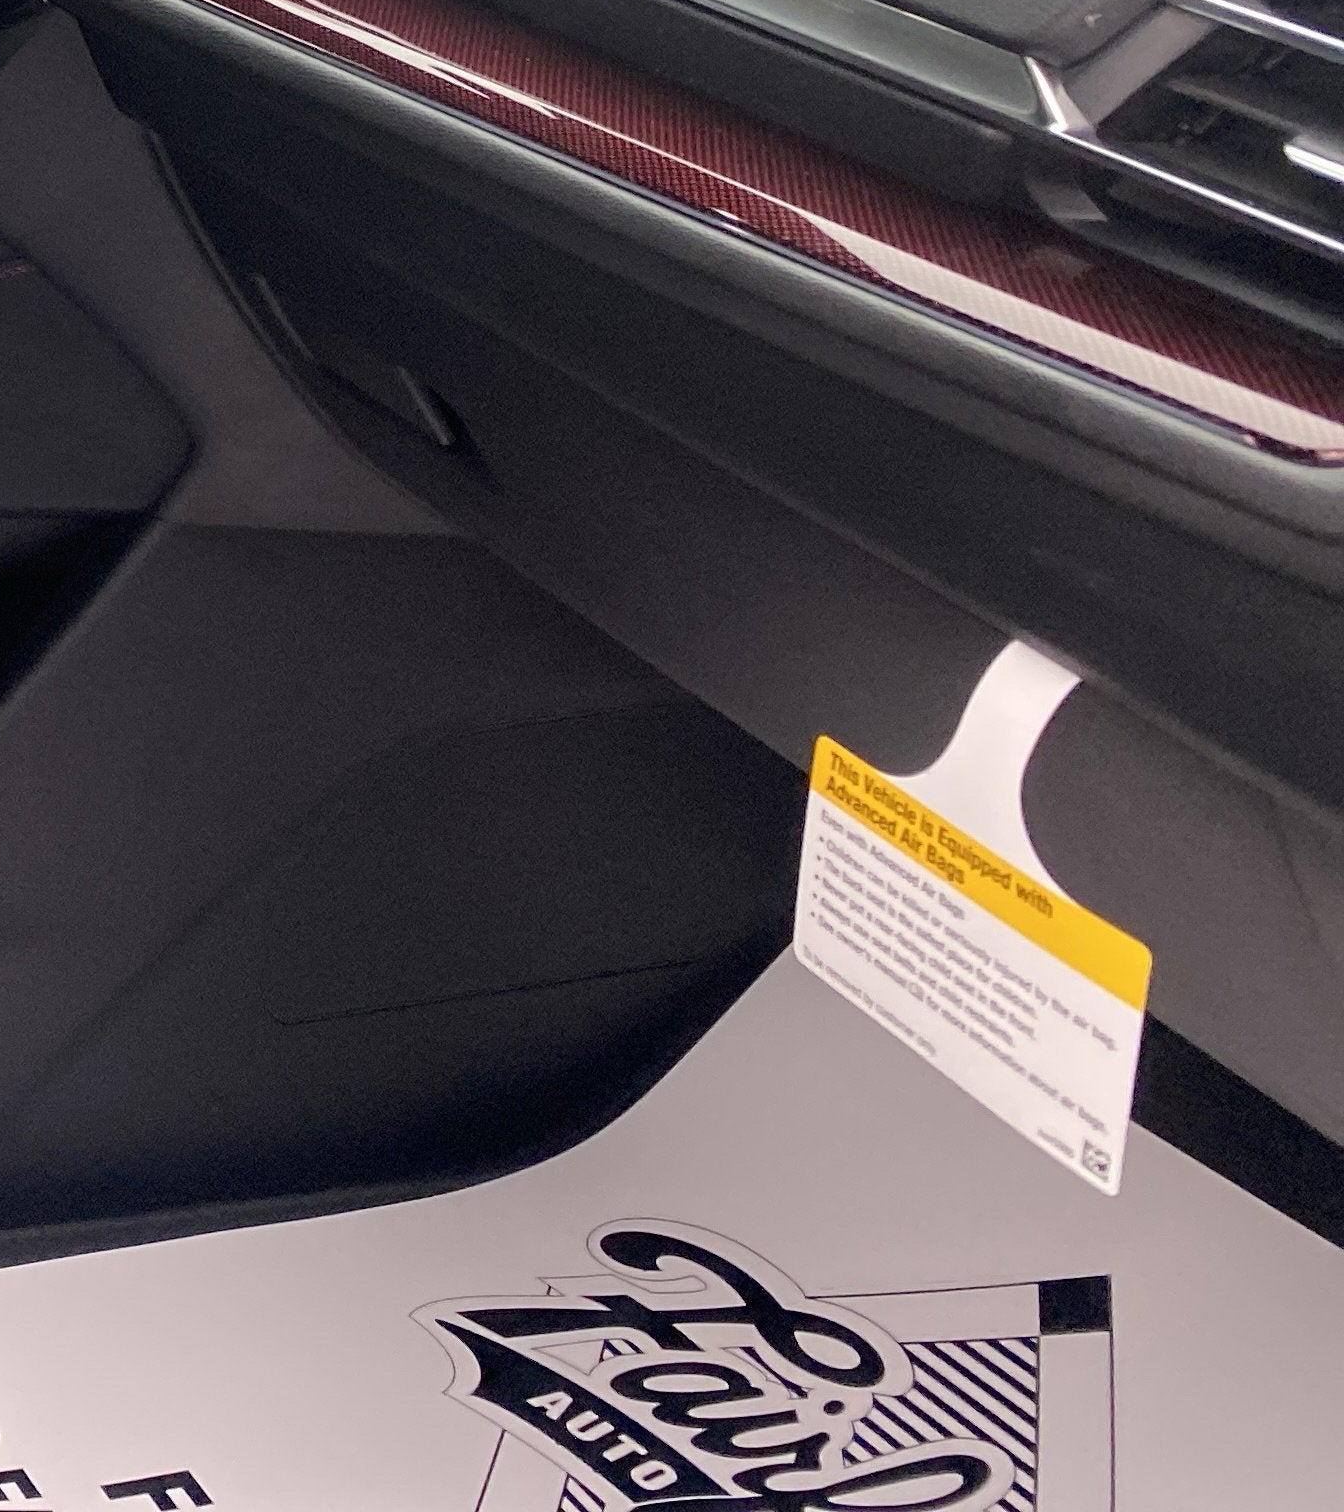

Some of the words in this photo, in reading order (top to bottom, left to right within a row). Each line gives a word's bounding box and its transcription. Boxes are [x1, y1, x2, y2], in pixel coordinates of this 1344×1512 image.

[824, 775, 899, 839] Advanced
[899, 827, 923, 854] Air
[925, 842, 966, 886] Bags
[830, 750, 861, 787] This
[863, 773, 918, 826] Vehicle
[919, 815, 935, 838] is
[937, 825, 1013, 891] Equipped
[1015, 882, 1054, 919] with
[525, 1387, 680, 1493] AUTO
